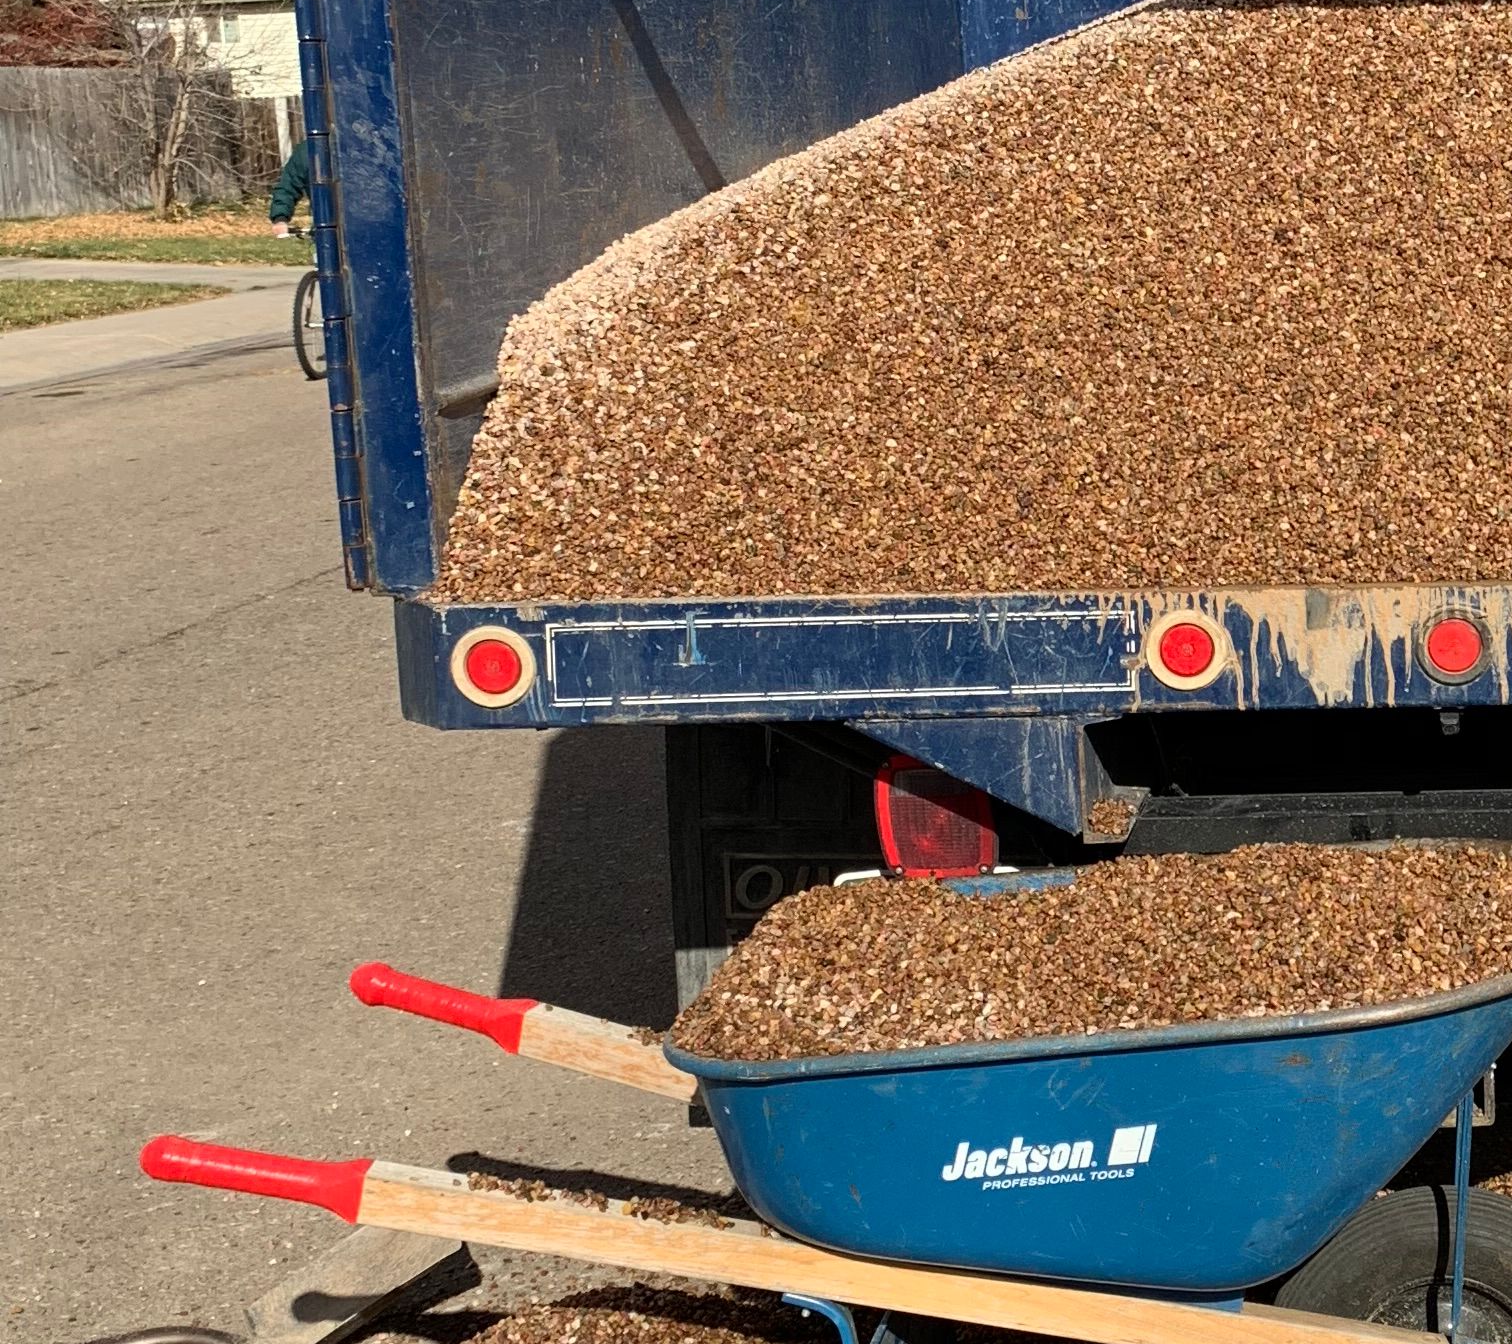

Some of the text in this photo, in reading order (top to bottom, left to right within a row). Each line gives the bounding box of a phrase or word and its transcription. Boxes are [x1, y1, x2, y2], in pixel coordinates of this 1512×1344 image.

[941, 1136, 1094, 1182] Jackson
[982, 1167, 1135, 1191] PROFESSIONAL TOOLS
